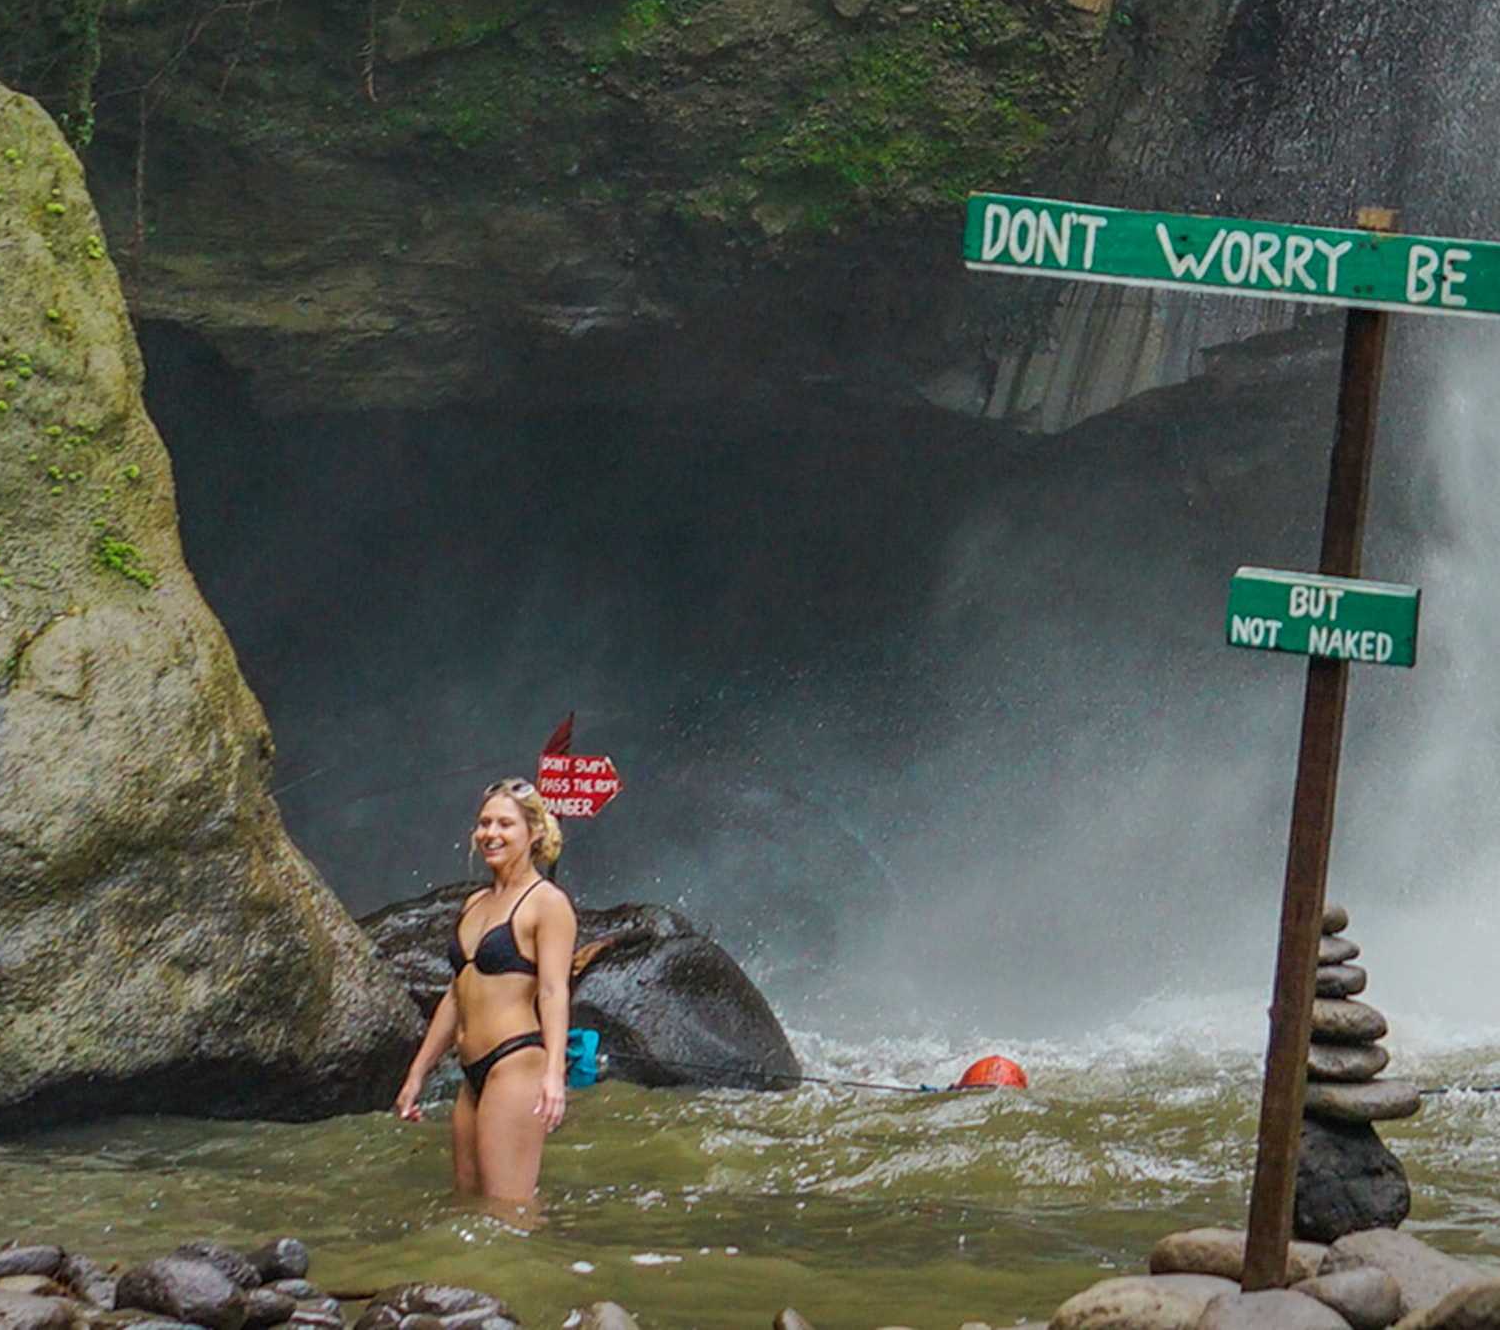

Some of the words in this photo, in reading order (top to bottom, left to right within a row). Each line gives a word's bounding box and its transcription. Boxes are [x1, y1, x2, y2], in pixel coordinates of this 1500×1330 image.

[981, 203, 1108, 270] DON'T
[1156, 223, 1353, 293] WORRY
[1406, 244, 1472, 307] BE
[1288, 585, 1346, 621] BUT
[1230, 614, 1283, 649] NOT
[1308, 625, 1393, 662] NAKED
[574, 758, 607, 774] SWIM
[540, 777, 571, 794] PASS
[573, 778, 593, 794] THE
